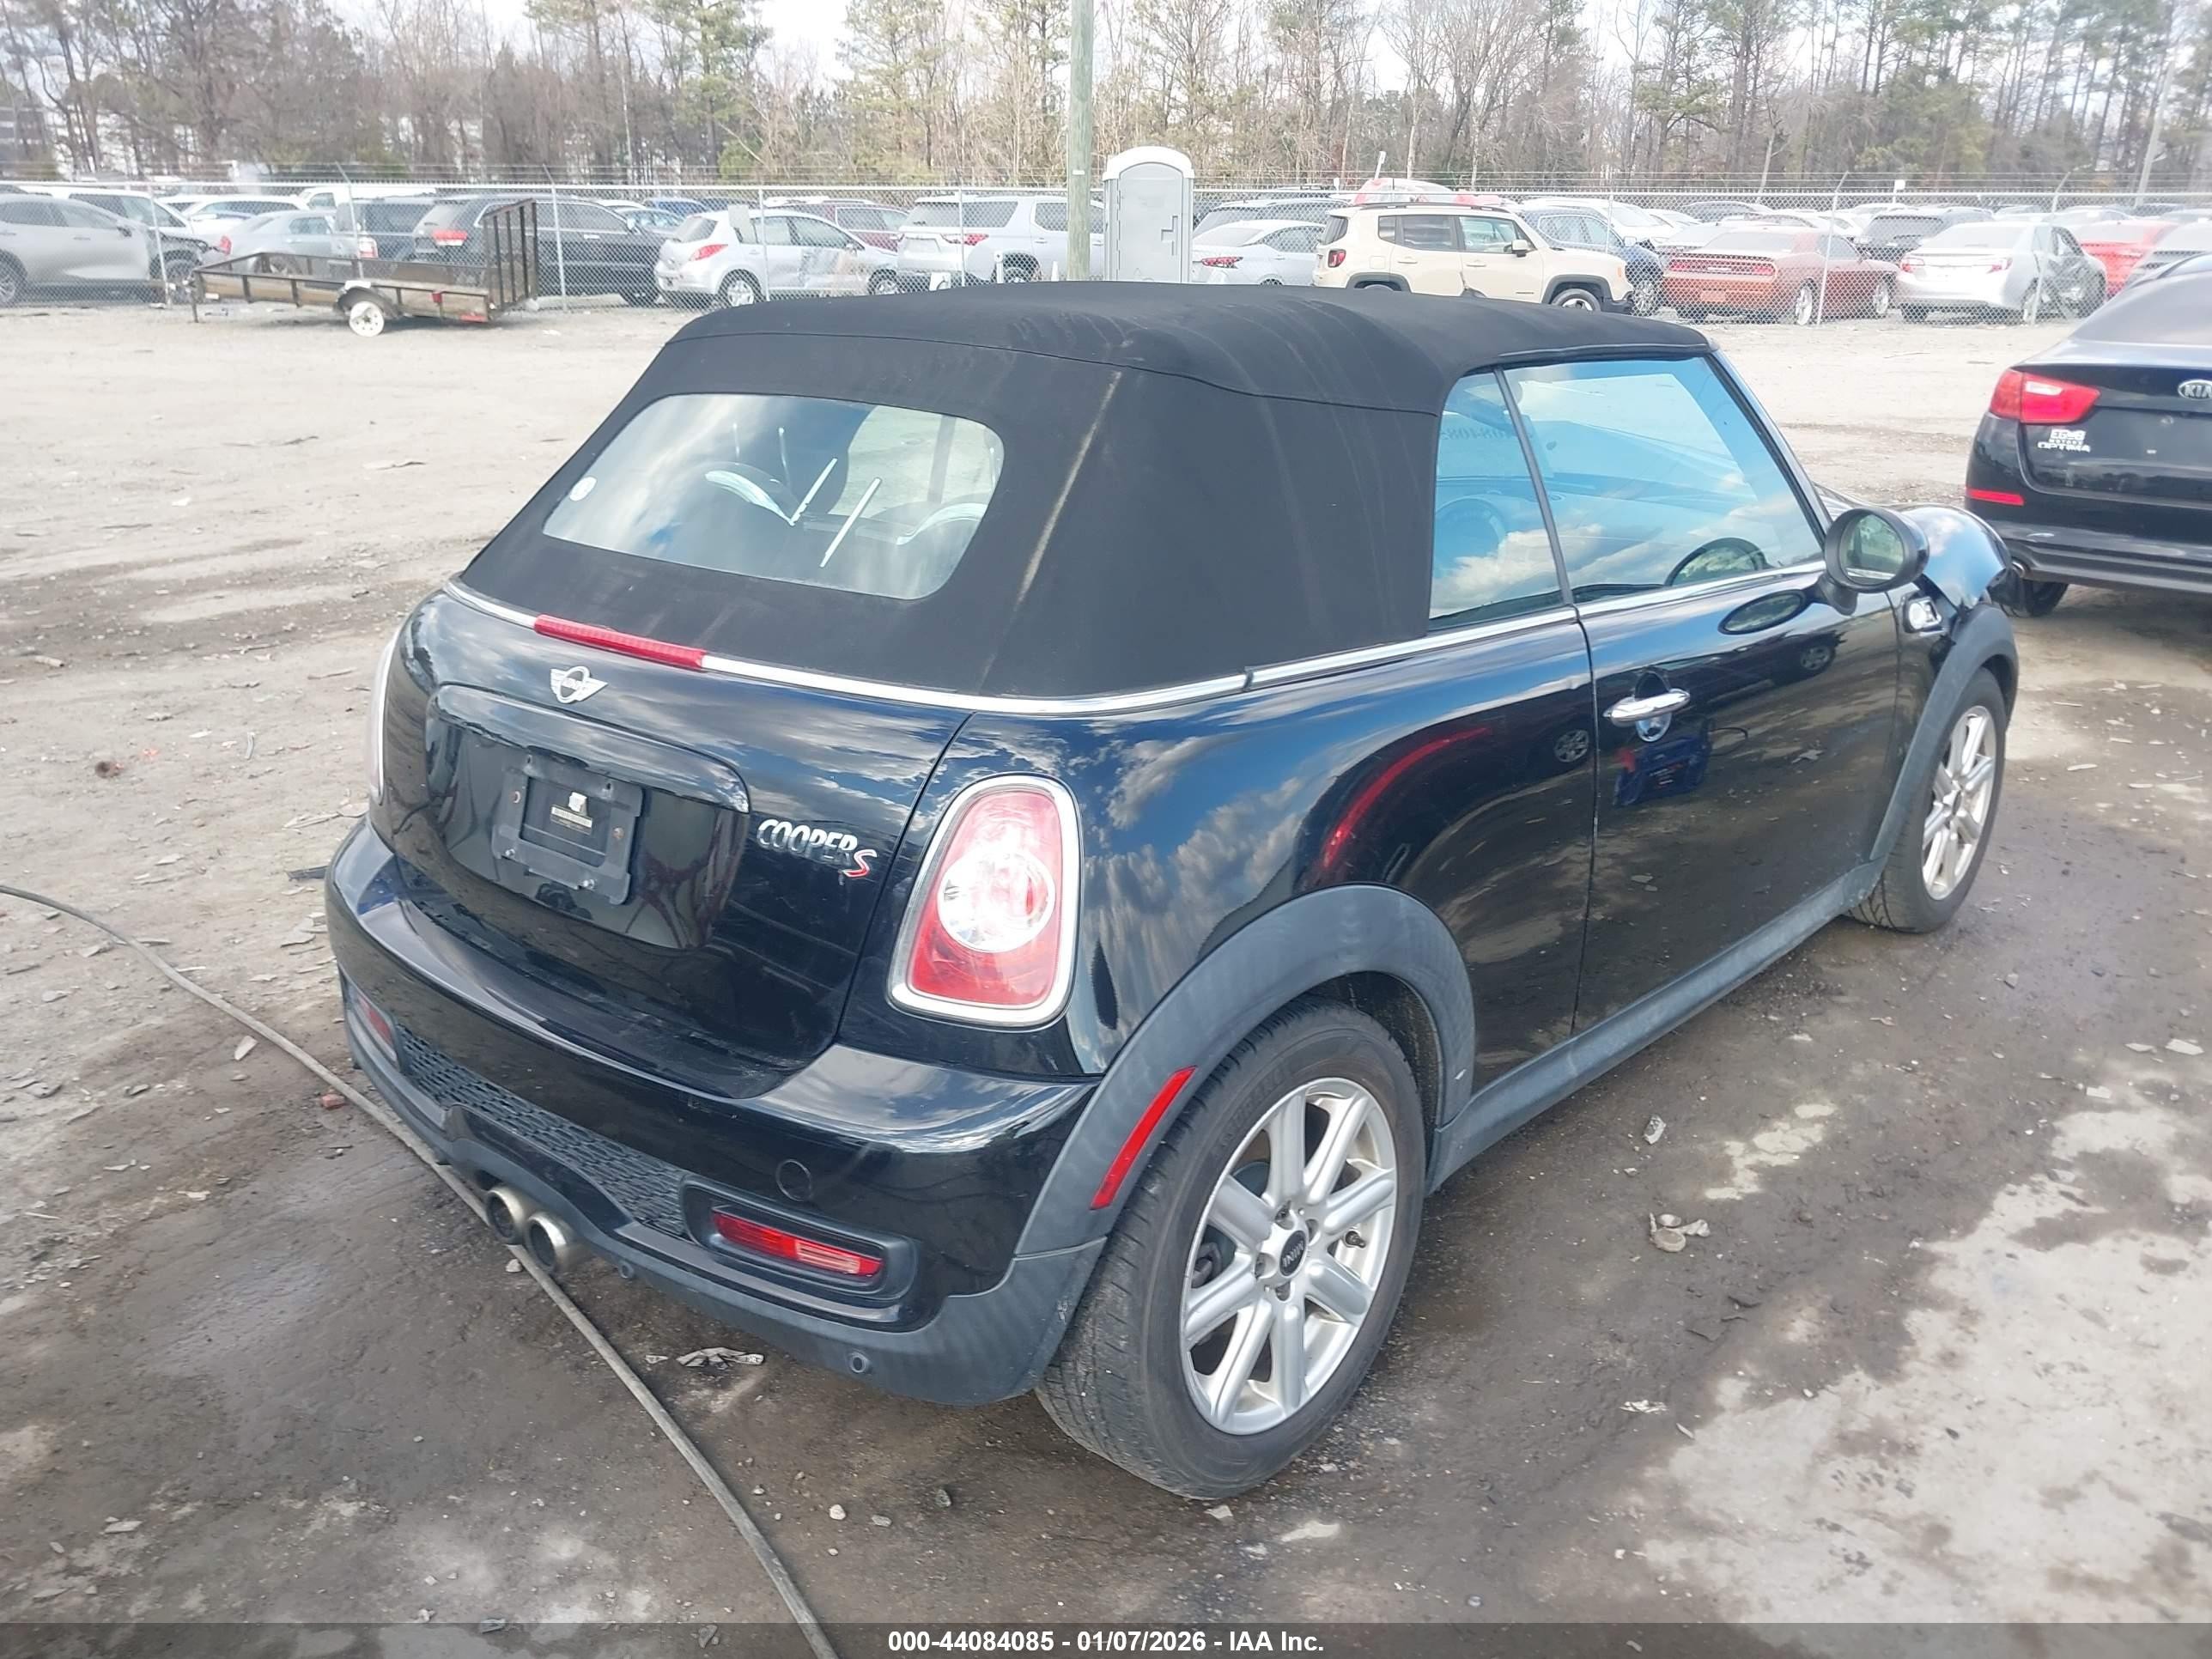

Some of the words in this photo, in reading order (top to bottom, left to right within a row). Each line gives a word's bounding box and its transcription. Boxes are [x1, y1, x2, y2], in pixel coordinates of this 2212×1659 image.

[2185, 384, 2212, 398] KIA
[757, 818, 857, 866] COOPER
[839, 848, 878, 878] S
